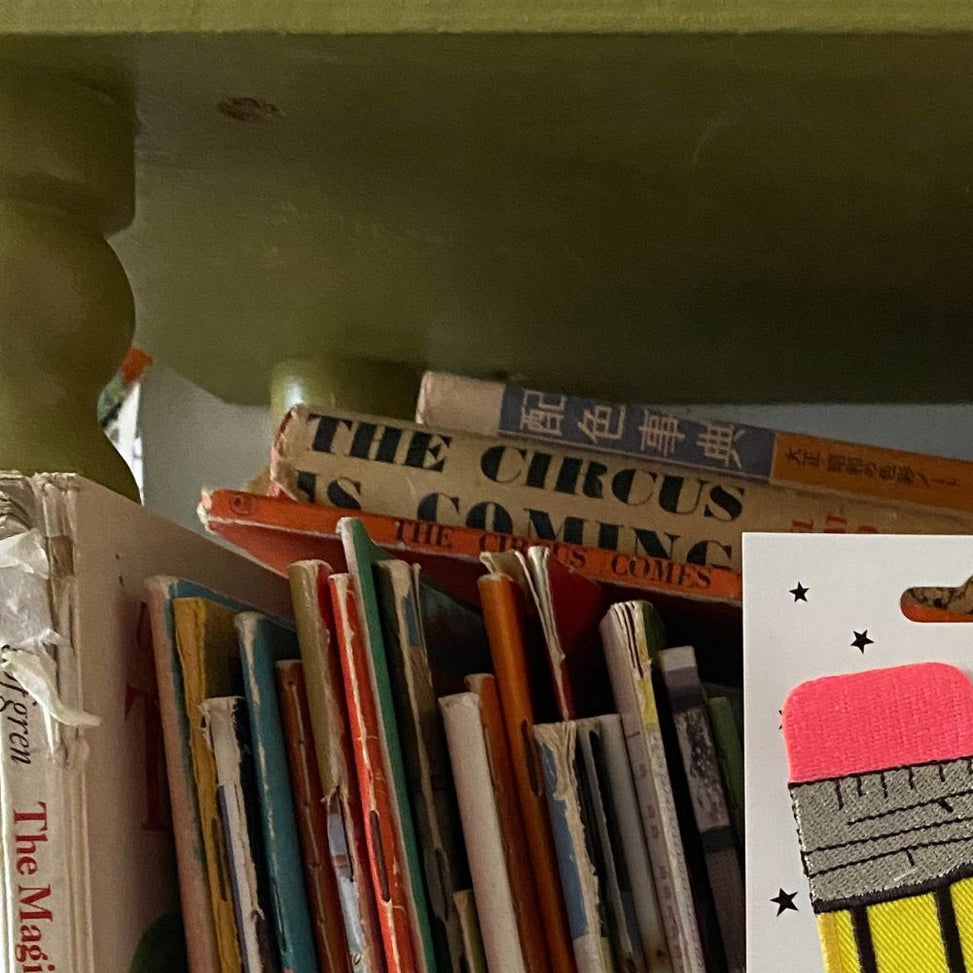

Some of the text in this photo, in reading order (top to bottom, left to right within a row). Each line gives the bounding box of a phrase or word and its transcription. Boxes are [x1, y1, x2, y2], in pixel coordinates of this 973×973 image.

[307, 413, 745, 522] THE CIRCUS
[297, 470, 733, 570] IS COMING
[397, 519, 713, 589] THE CIRUS COMES
[13, 801, 48, 875] The
